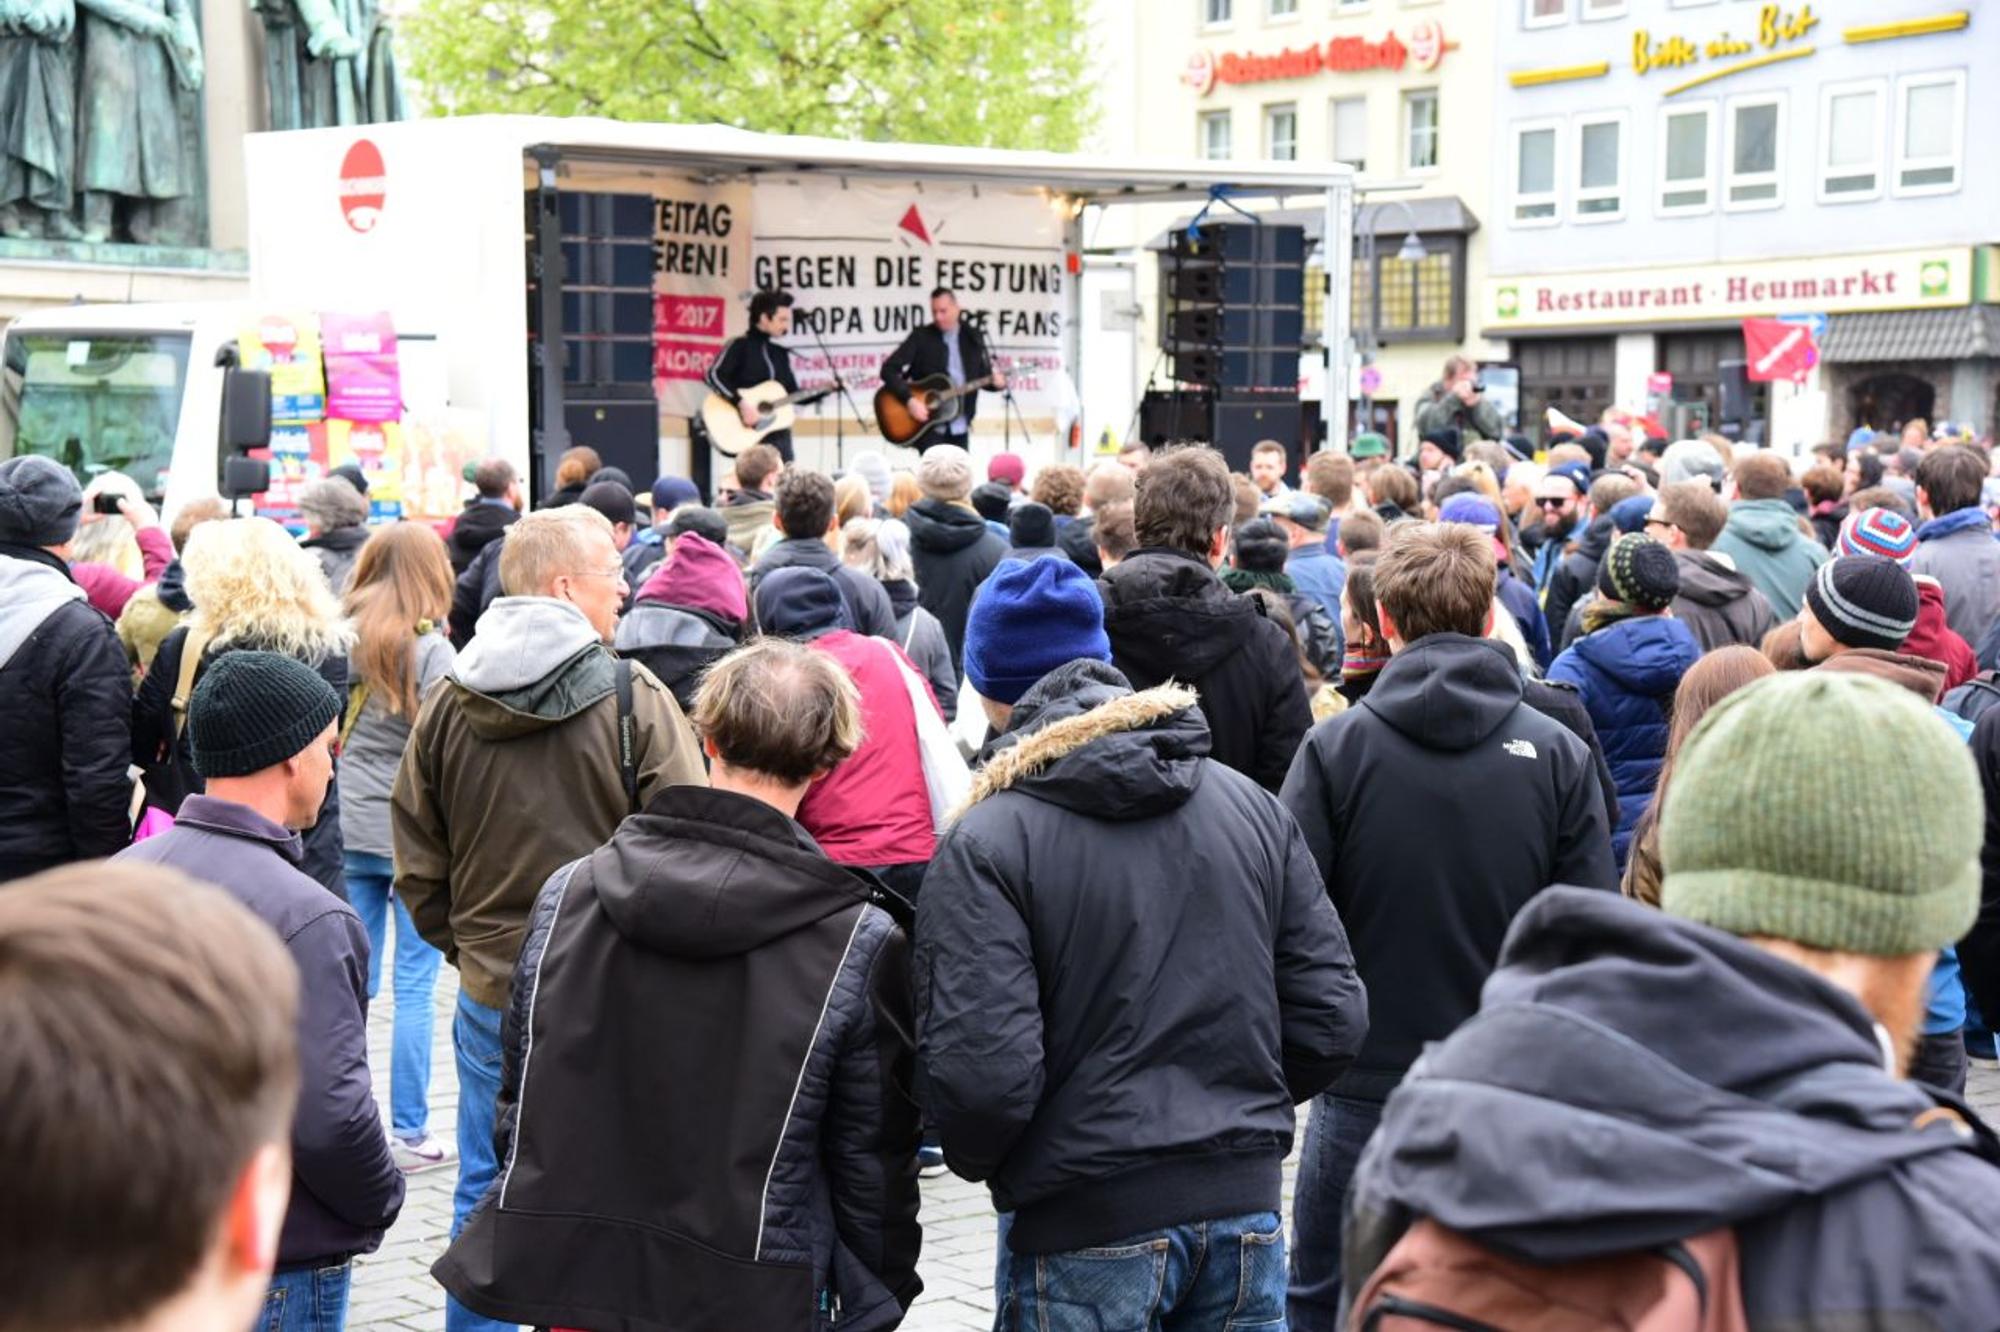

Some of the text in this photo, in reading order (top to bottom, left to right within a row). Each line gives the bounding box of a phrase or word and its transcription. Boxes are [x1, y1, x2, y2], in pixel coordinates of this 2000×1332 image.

[1758, 4, 1820, 48] Bit
[656, 198, 731, 237] EITAG
[755, 255, 1062, 294] GEGEN DIE FESTUNG
[1536, 269, 1897, 312] Restaurant Heumarkt
[674, 303, 719, 329] 2017
[792, 306, 863, 335] ROPA
[874, 304, 925, 332] UND
[998, 309, 1062, 337] FANS
[621, 715, 631, 767] Panasonic
